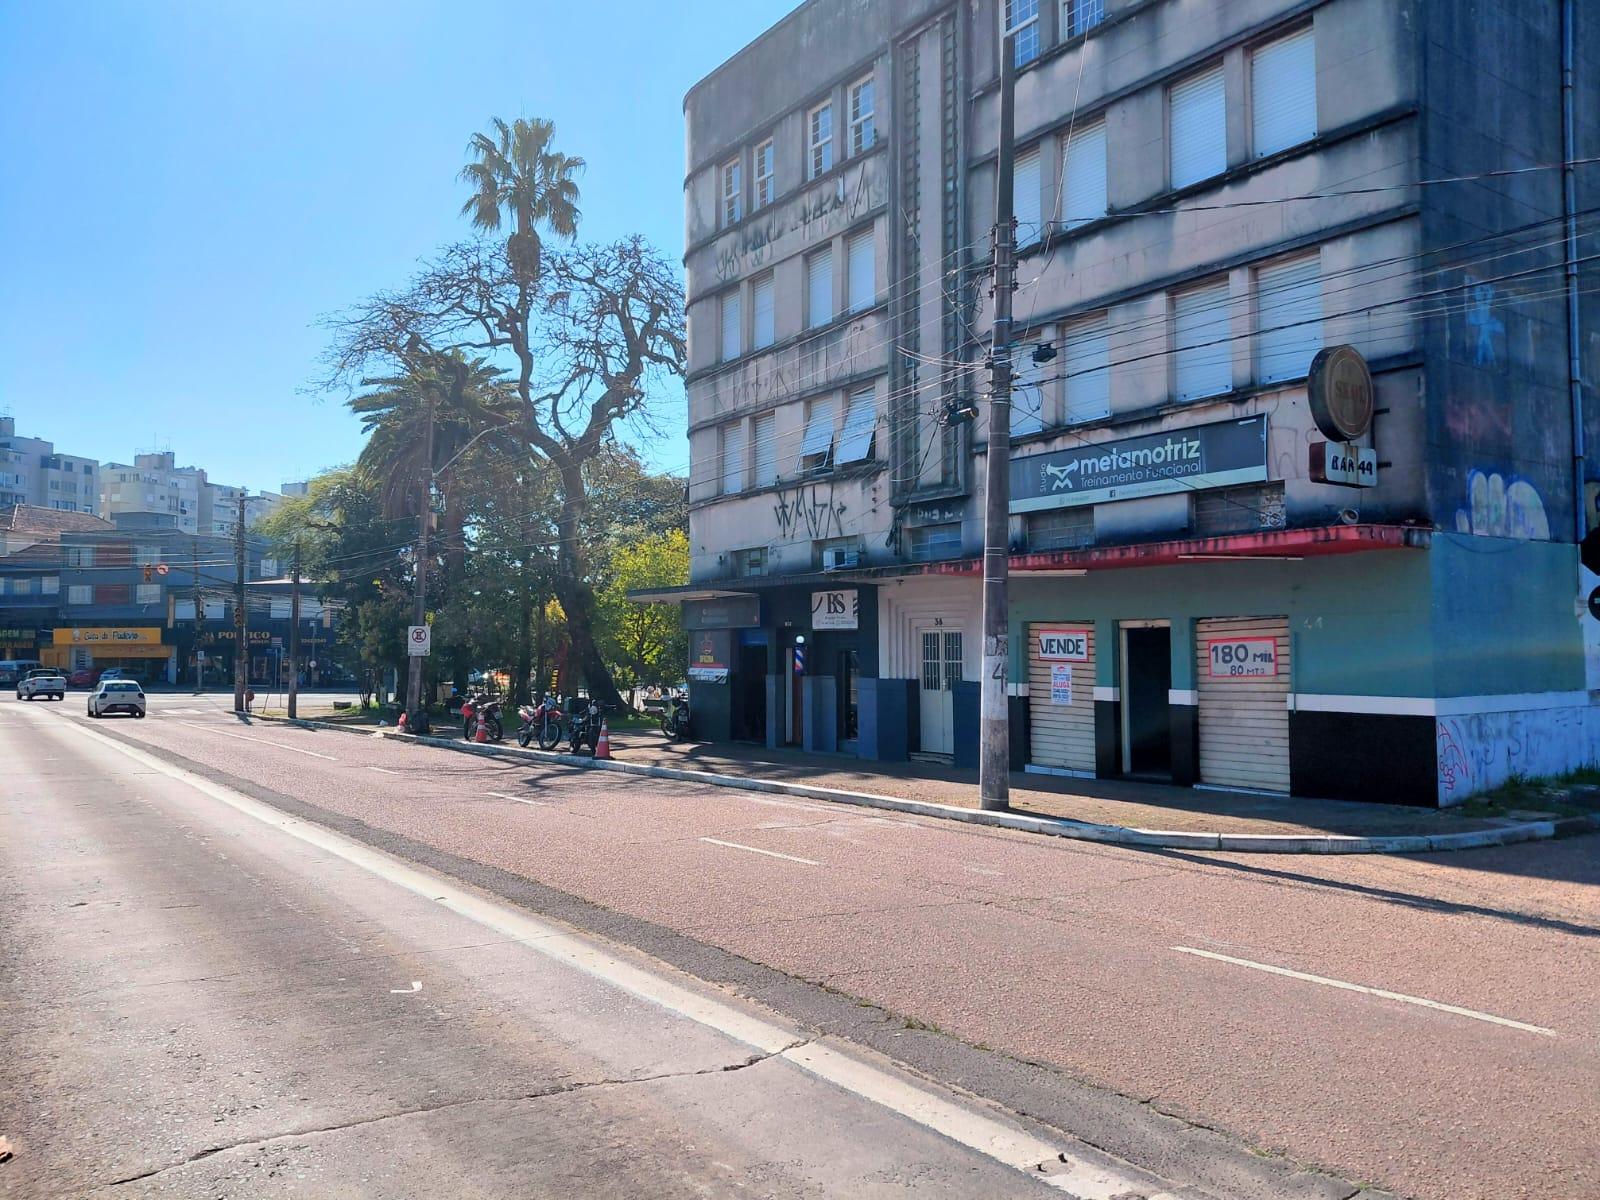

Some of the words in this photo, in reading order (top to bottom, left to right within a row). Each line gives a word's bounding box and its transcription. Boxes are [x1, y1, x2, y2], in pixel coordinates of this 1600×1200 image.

[1080, 437, 1201, 475] metamotriz
[1331, 455, 1355, 473] BAR
[1080, 468, 1143, 488] Treinamento
[1146, 460, 1201, 479] Funcional
[826, 593, 846, 614] BS
[1038, 638, 1084, 655] VENDE
[1211, 644, 1249, 664] 180
[1230, 665, 1244, 676] 80
